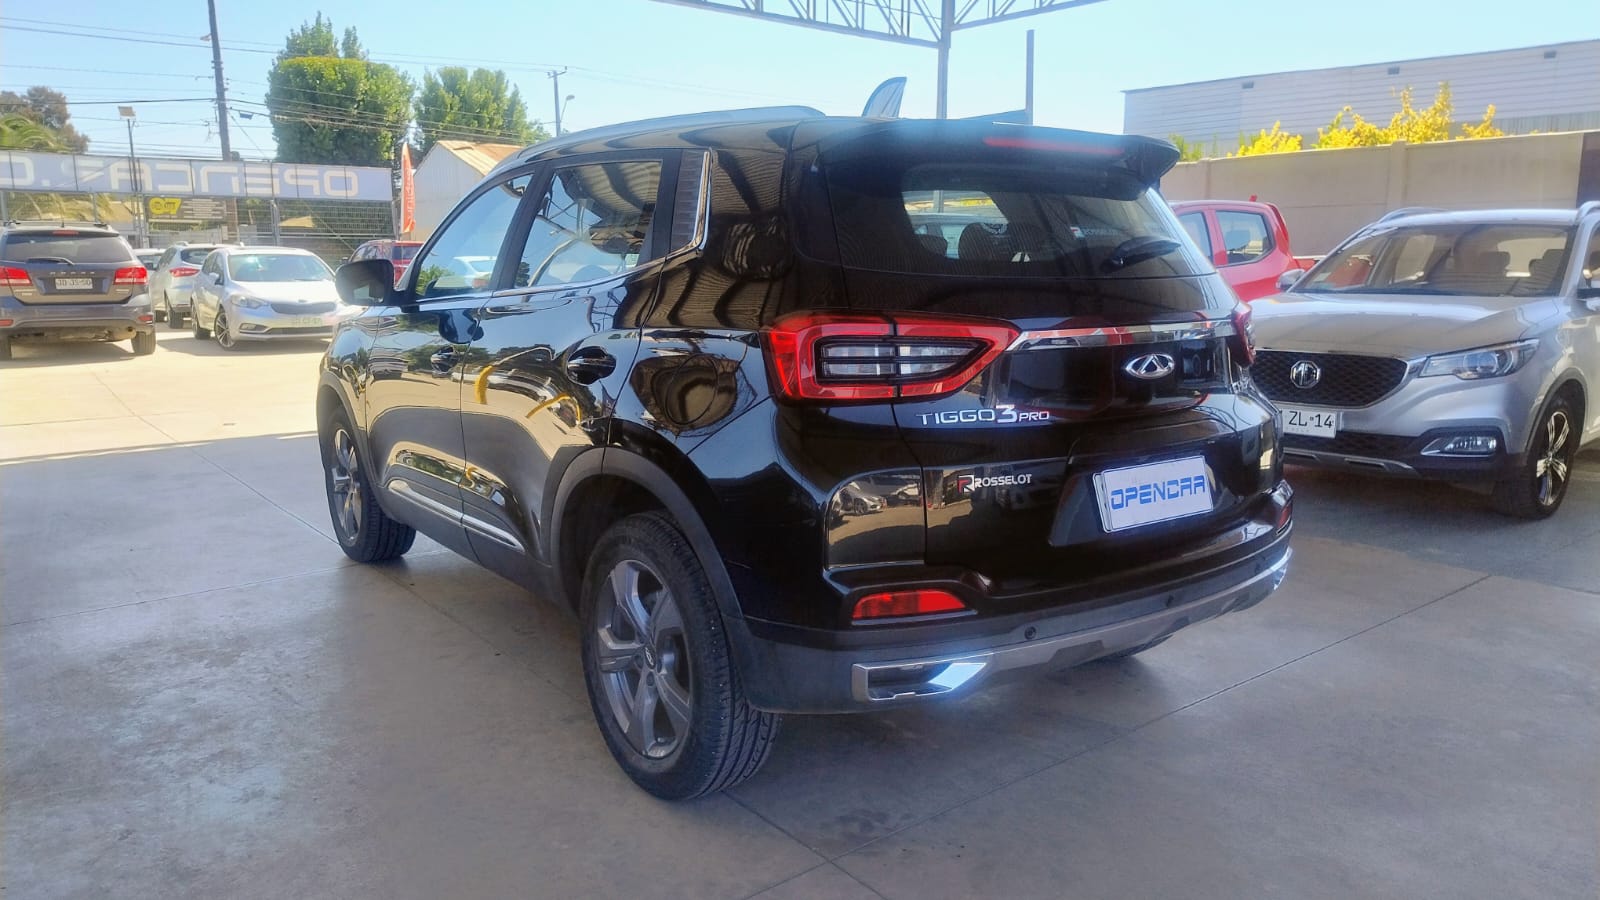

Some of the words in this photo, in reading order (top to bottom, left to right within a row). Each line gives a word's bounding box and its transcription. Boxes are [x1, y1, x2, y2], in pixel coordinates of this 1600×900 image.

[916, 409, 995, 425] TIGGO
[995, 404, 1017, 423] 3
[1019, 411, 1050, 421] PRO
[974, 474, 1032, 488] ROSSELOT
